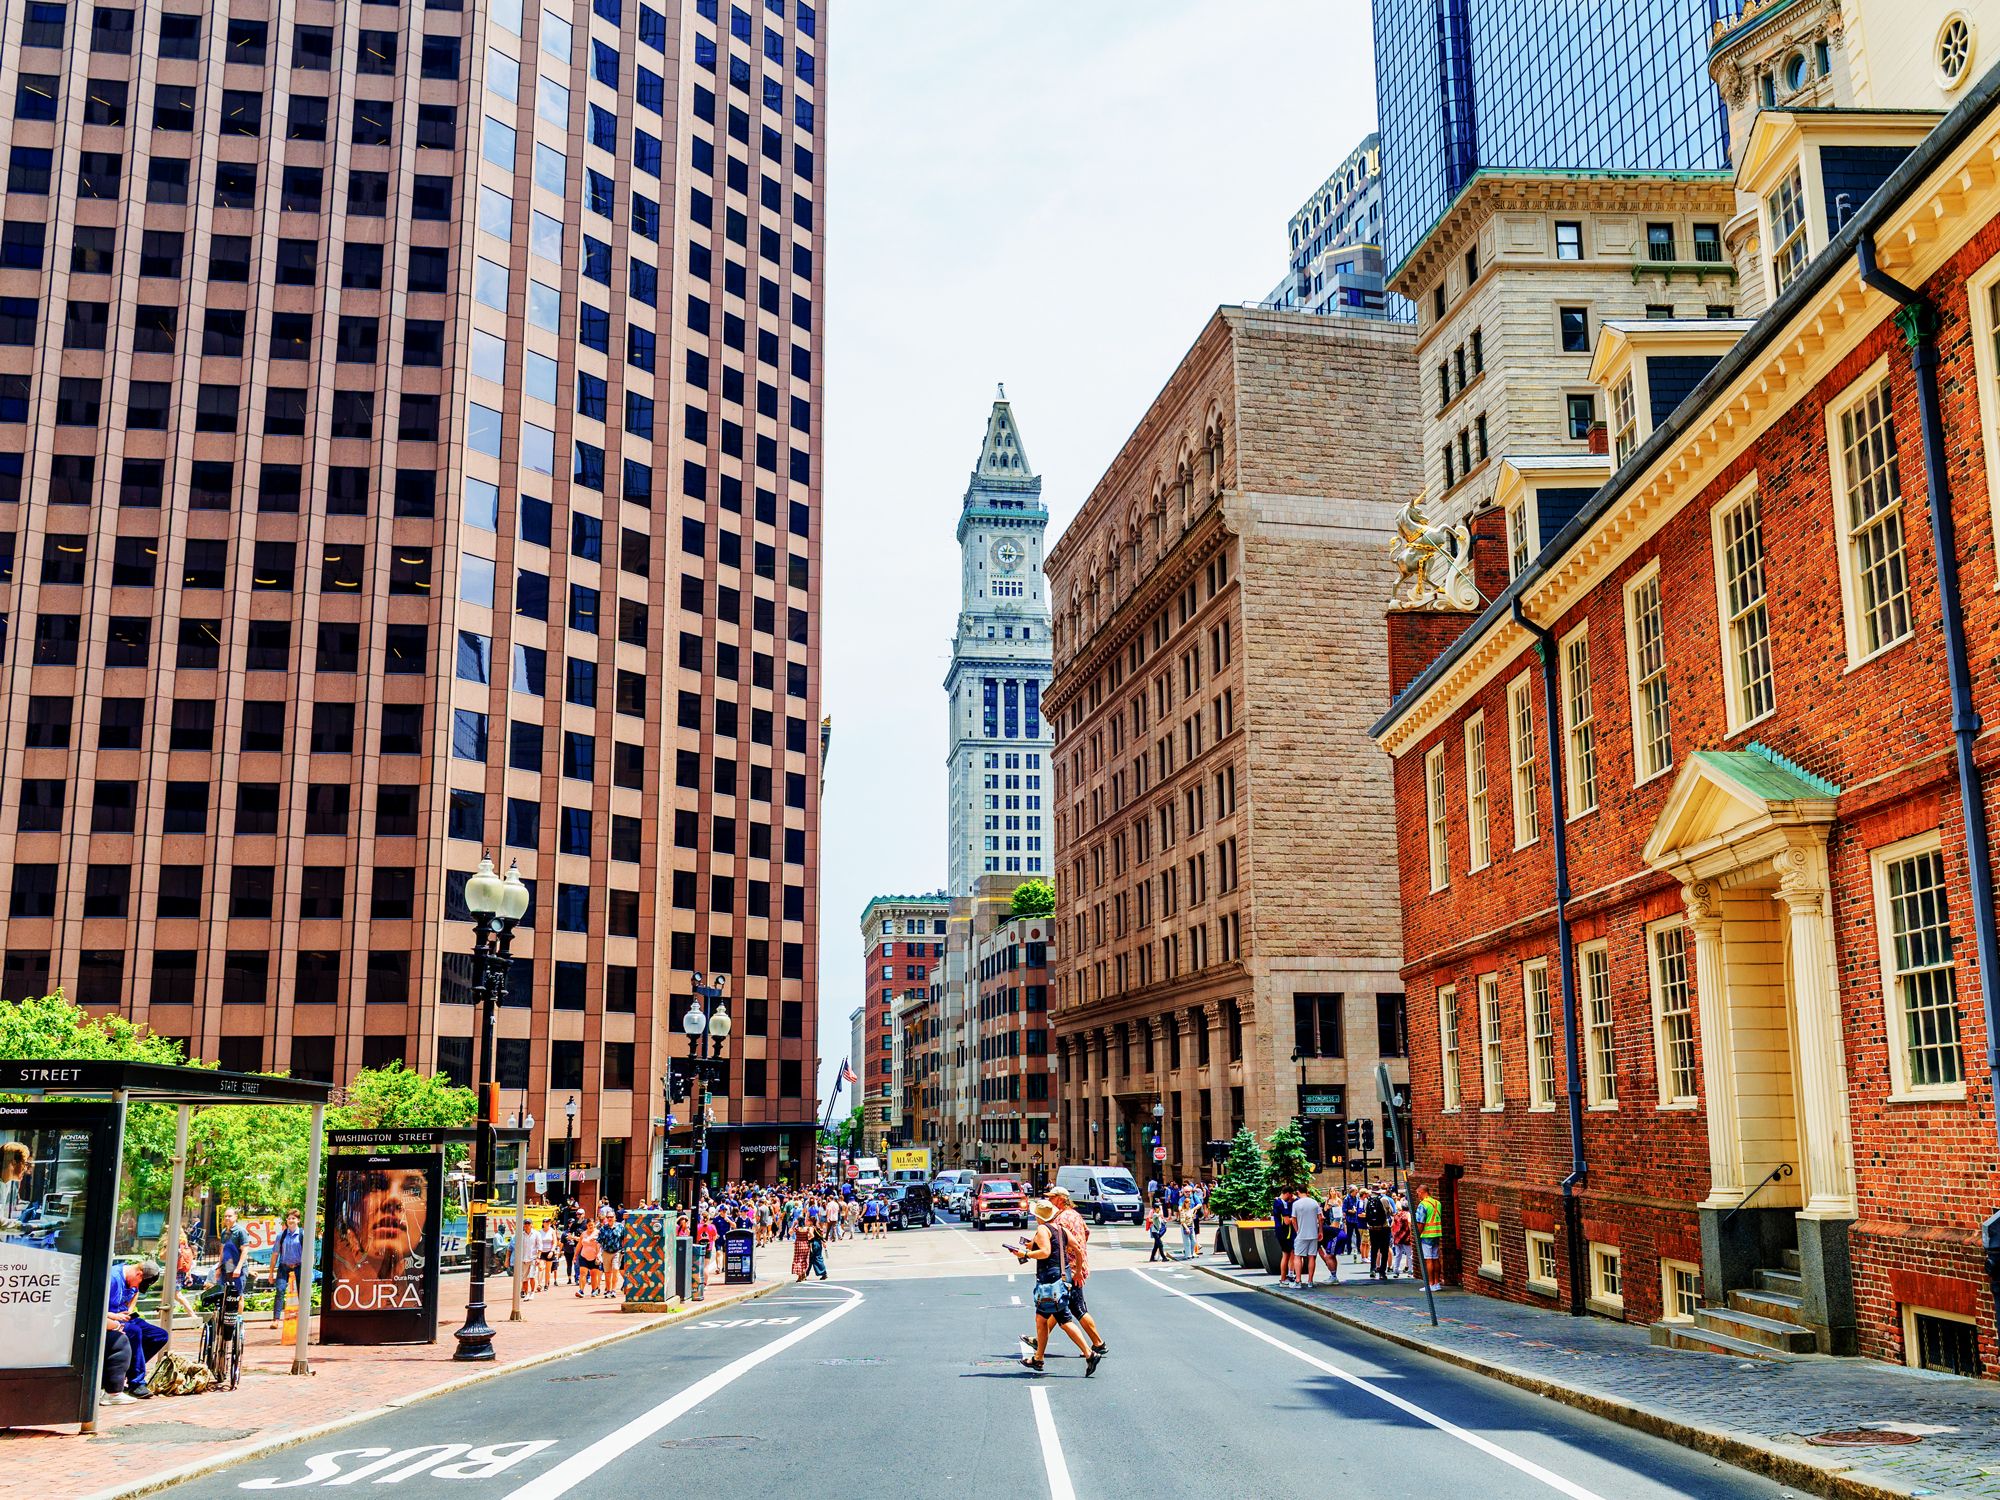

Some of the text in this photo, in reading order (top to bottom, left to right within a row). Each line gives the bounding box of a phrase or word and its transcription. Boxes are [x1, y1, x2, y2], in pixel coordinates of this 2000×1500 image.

[20, 1069, 82, 1081] STREET
[220, 1080, 260, 1094] STATE STREET
[0, 1107, 28, 1115] Decaux
[335, 1132, 434, 1143] WASHINGTON STREET
[9, 1274, 60, 1288] STAGE
[0, 1290, 52, 1304] STAGE
[682, 1316, 802, 1330] BUS
[237, 1439, 560, 1490] BUS
